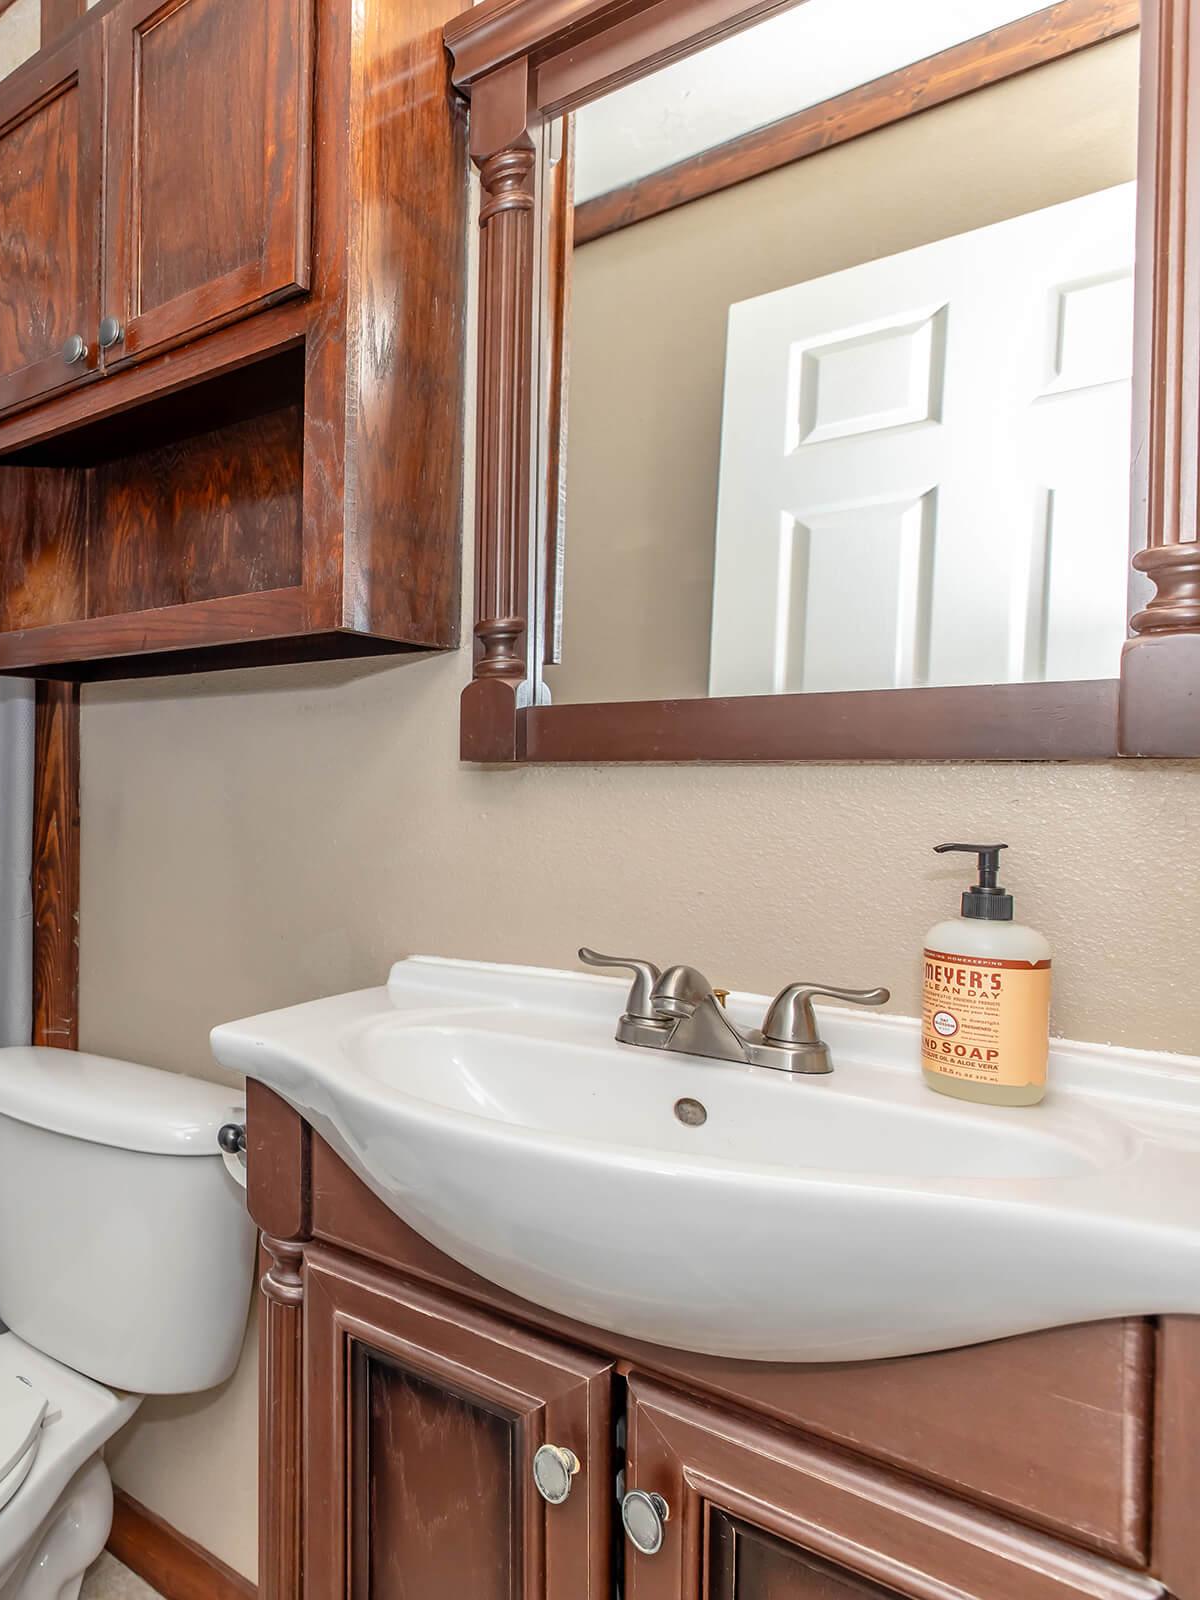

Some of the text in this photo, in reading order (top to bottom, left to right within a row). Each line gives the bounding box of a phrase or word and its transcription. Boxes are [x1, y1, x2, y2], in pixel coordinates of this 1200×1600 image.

[926, 962, 1002, 990] MEYER'S
[925, 980, 960, 994] CLEAN
[967, 989, 1001, 999] DAY
[942, 1041, 999, 1061] SOAP
[957, 1059, 976, 1067] ALOE
